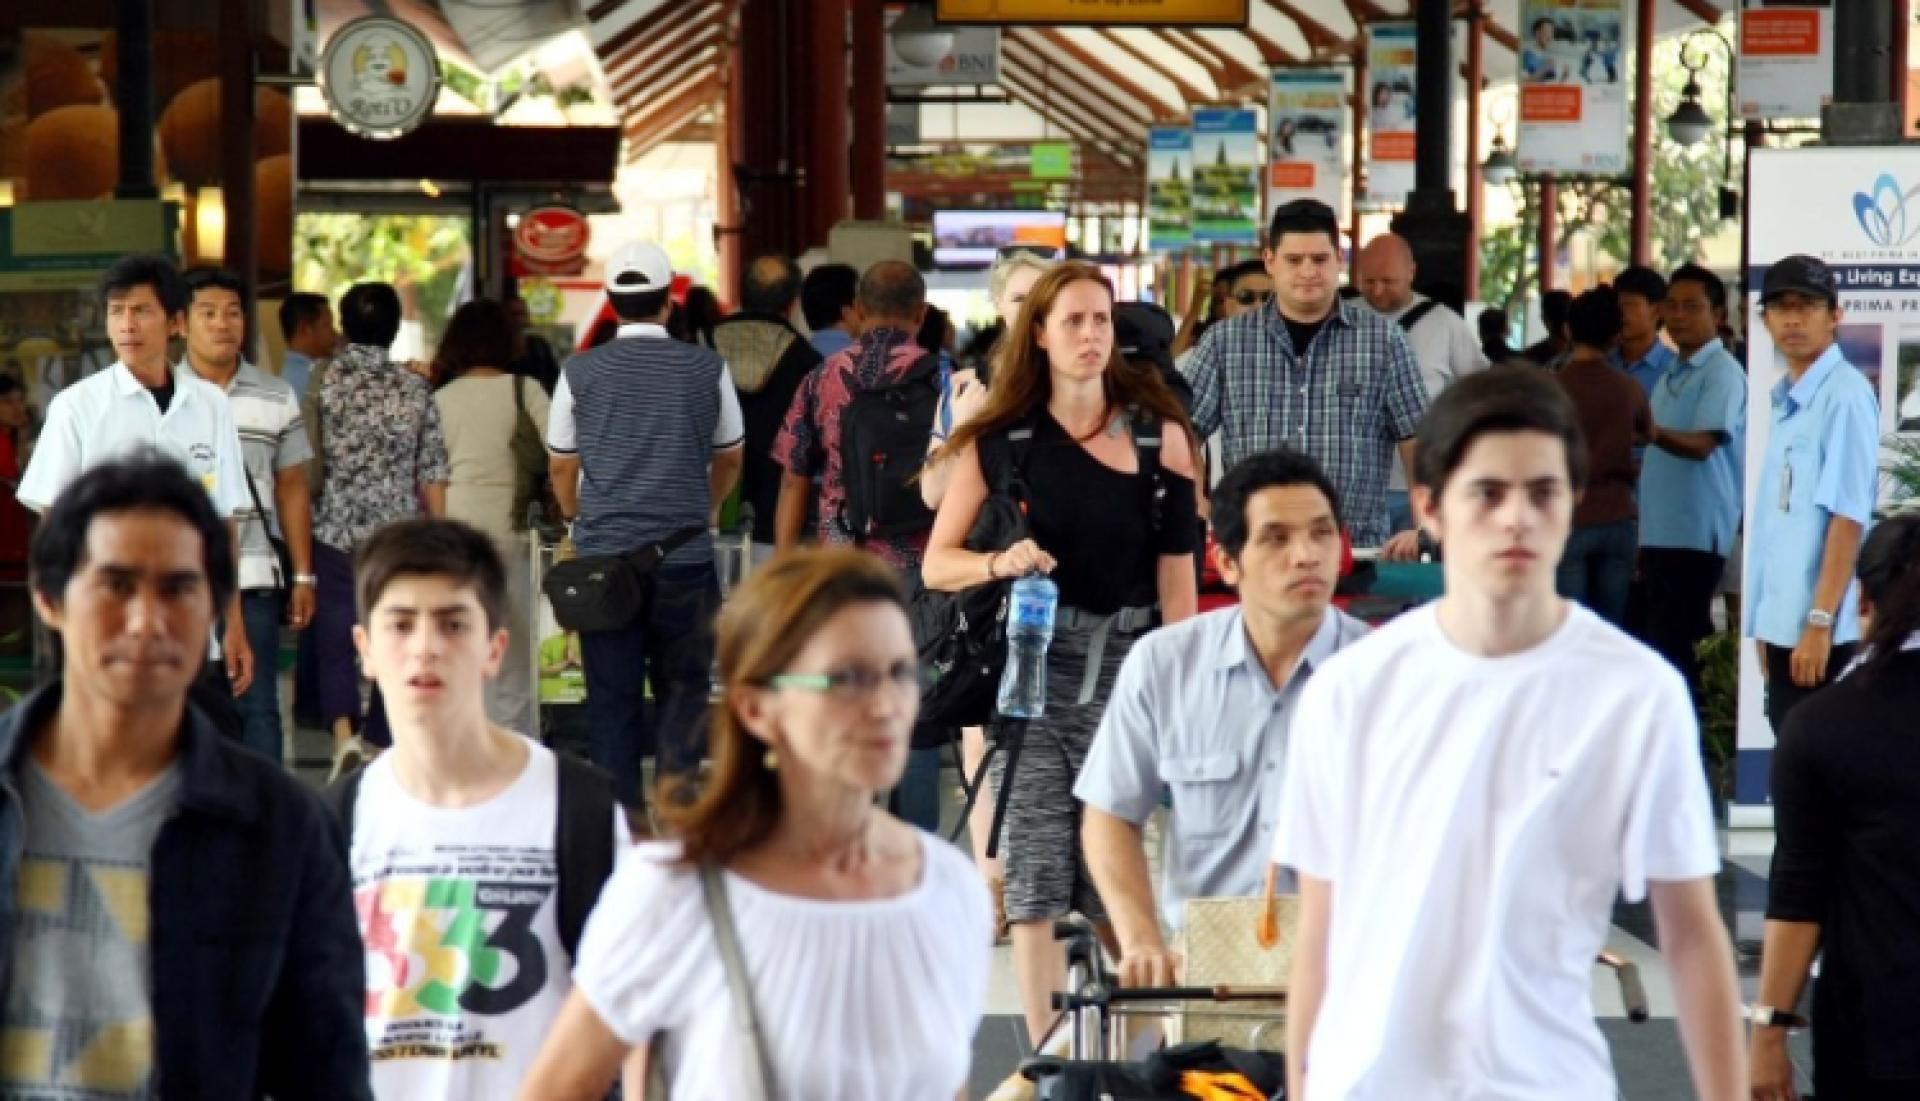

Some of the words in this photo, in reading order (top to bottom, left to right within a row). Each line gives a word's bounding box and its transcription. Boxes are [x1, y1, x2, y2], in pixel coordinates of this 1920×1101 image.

[957, 54, 994, 72] BNI
[1847, 268, 1894, 288] Living
[1844, 299, 1894, 311] PRIMA
